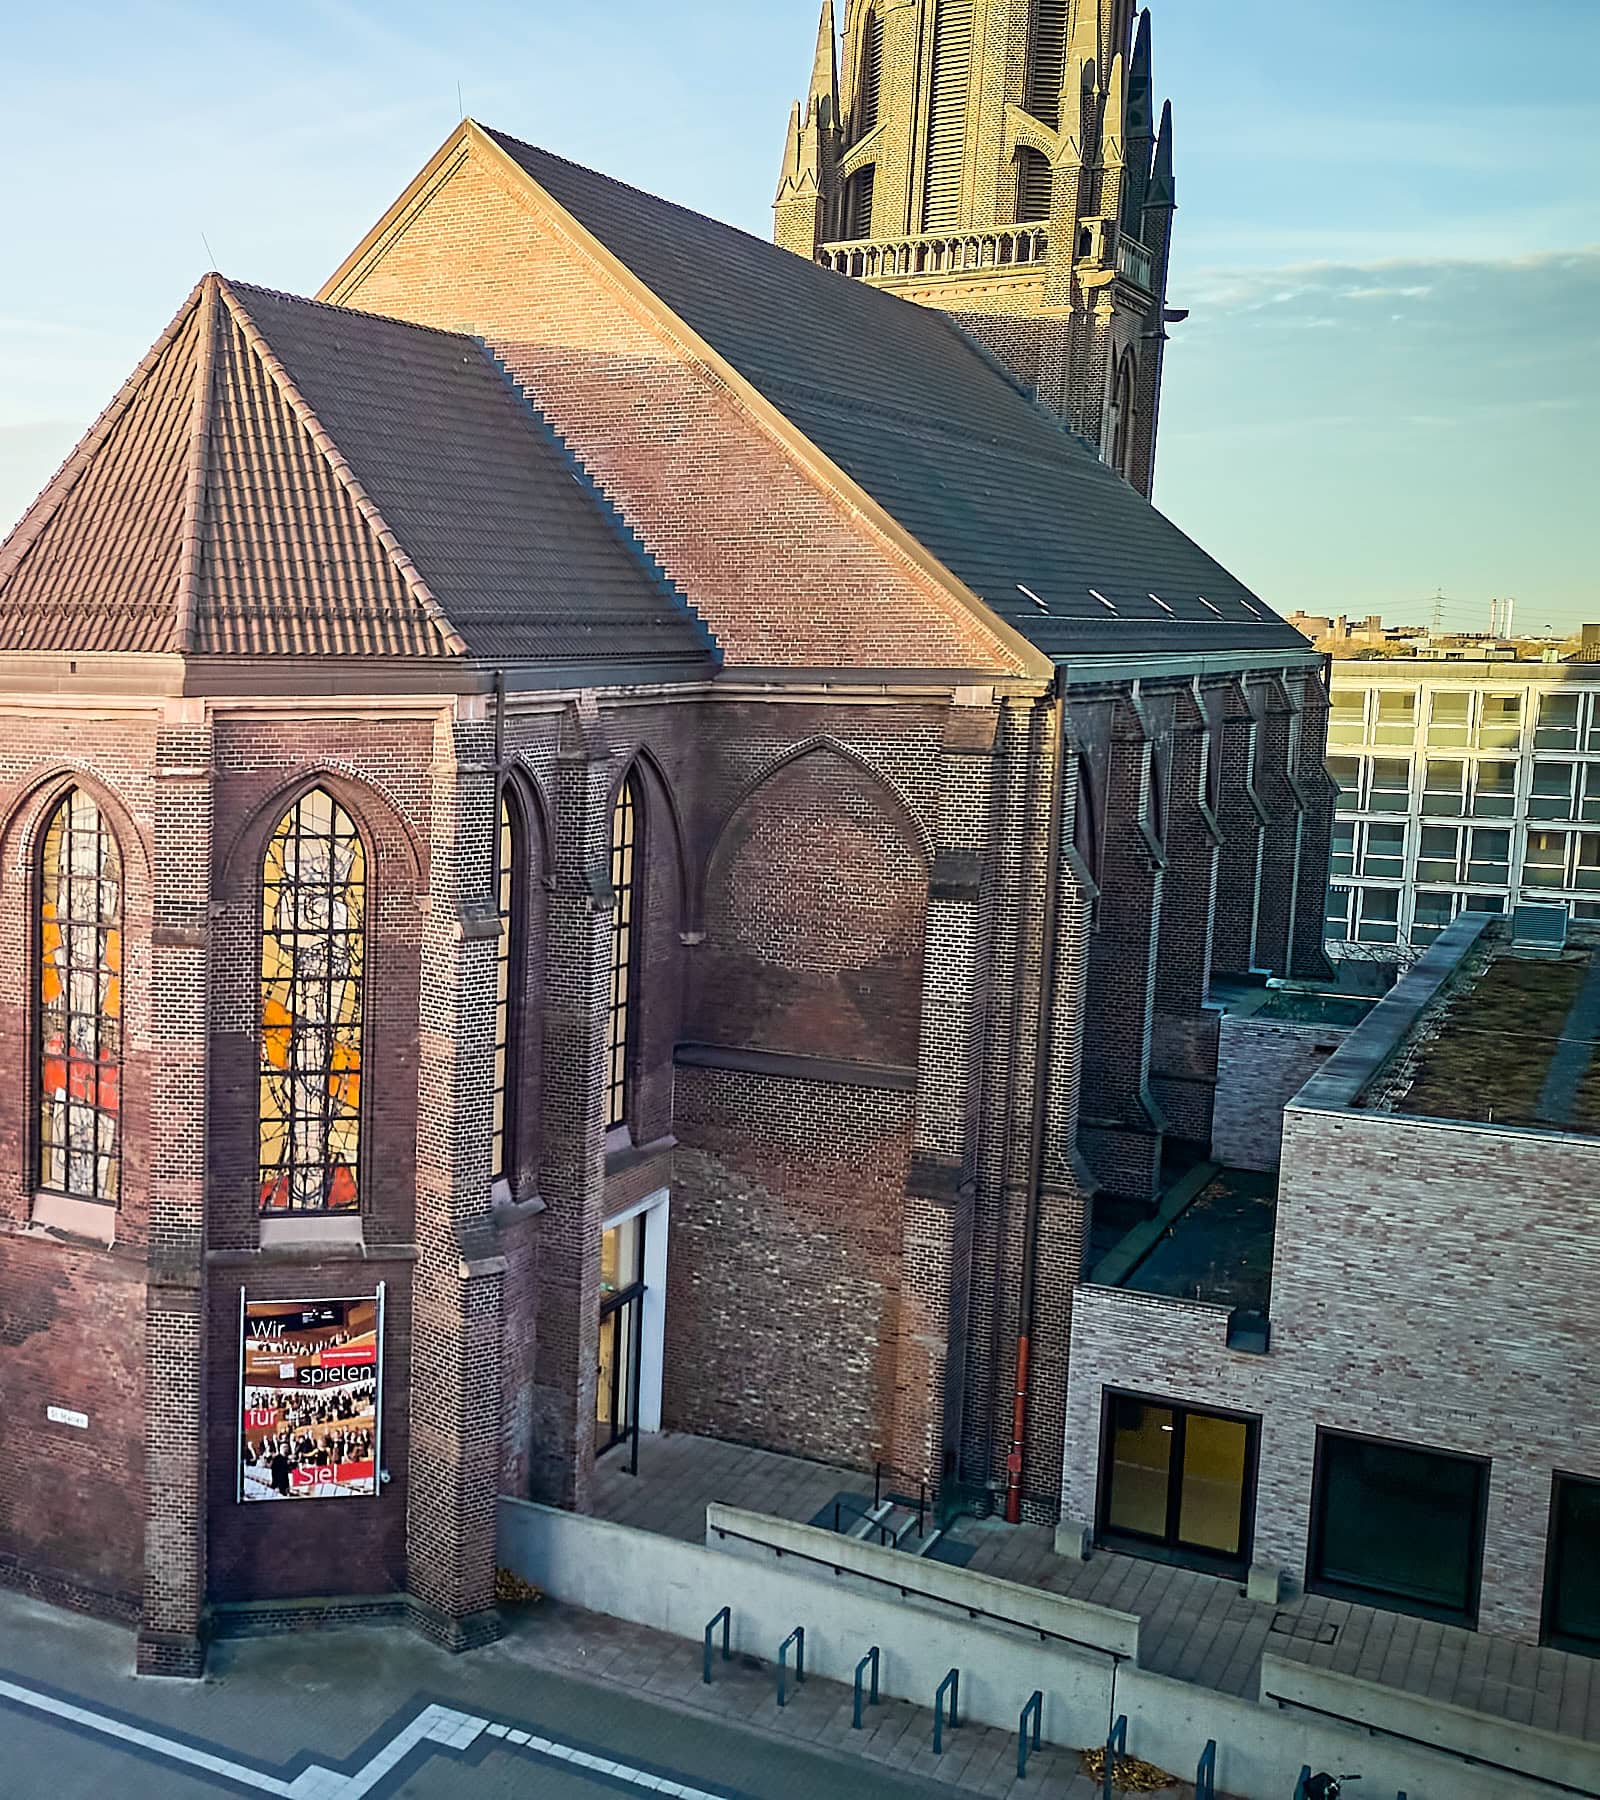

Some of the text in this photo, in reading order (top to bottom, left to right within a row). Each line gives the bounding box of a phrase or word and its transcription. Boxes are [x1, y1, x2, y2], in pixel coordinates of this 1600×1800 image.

[251, 1320, 286, 1339] Wir
[300, 1363, 371, 1386] spielen
[249, 1408, 277, 1426] für
[299, 1464, 338, 1485] Sie!
